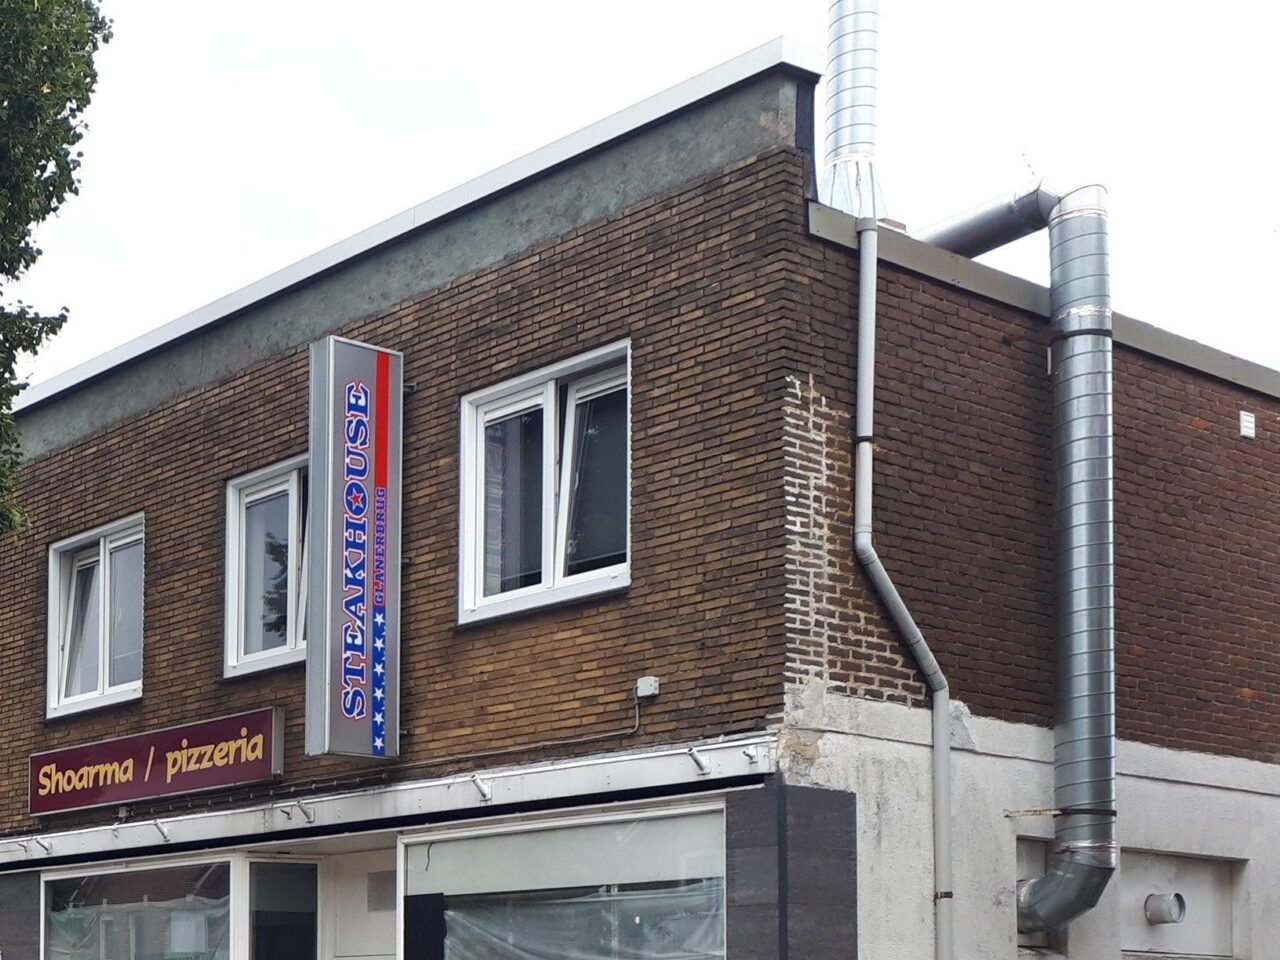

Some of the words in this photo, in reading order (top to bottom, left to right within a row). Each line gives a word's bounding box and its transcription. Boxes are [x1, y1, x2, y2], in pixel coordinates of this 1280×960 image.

[341, 382, 370, 720] STEAKHOUSE
[374, 488, 388, 606] GLANERBRUG
[38, 757, 133, 796] Shoarma
[144, 746, 155, 782] /
[166, 727, 264, 783] pizzeria
